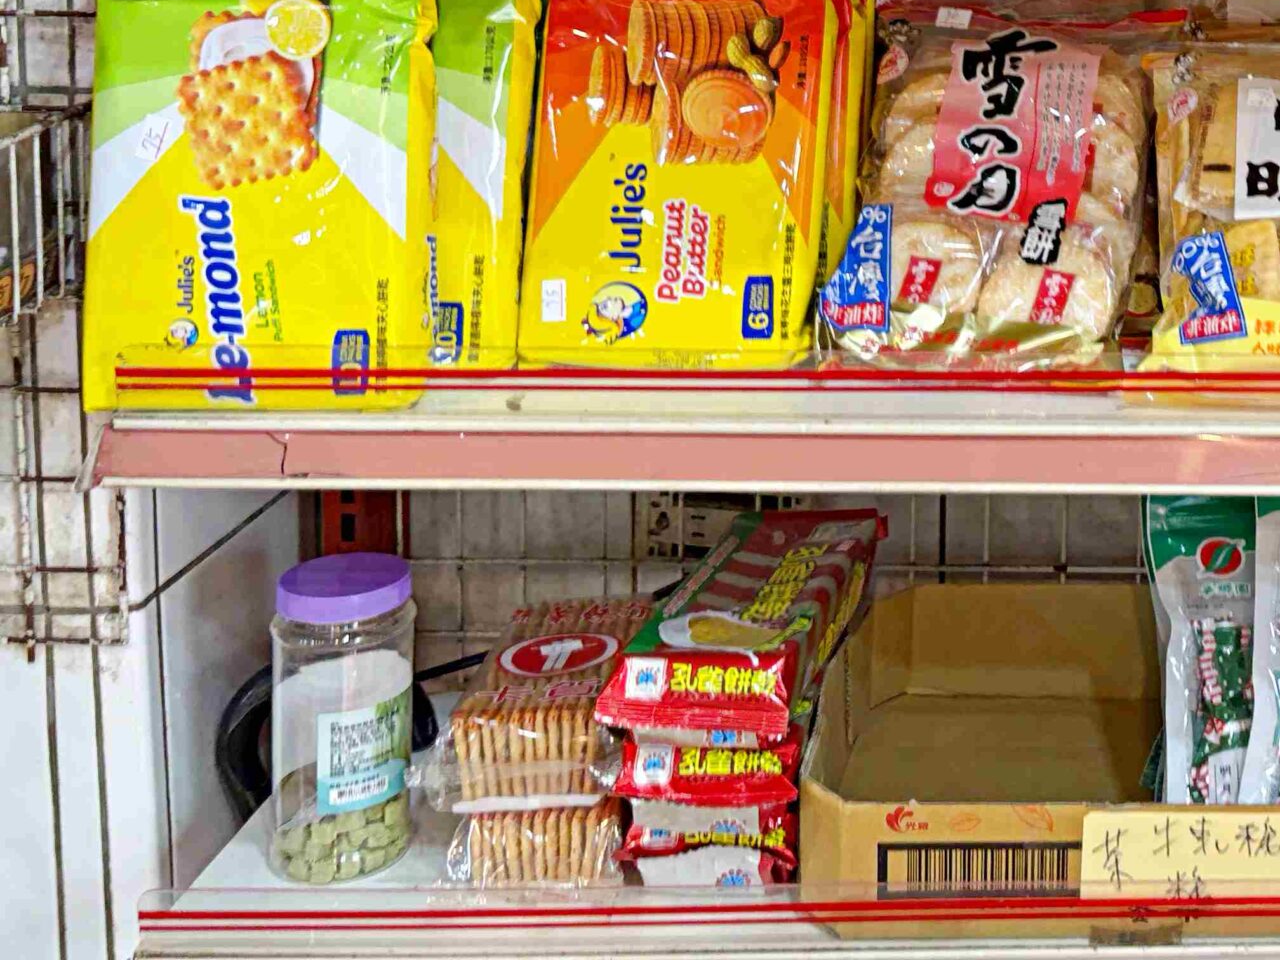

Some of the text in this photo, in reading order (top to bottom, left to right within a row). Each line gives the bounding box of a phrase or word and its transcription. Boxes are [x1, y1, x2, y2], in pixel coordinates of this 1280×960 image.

[607, 161, 649, 276] Julie's
[655, 198, 689, 302] Peanut
[681, 207, 710, 298] Butter
[176, 254, 196, 315] Julie's
[747, 311, 770, 331] 6
